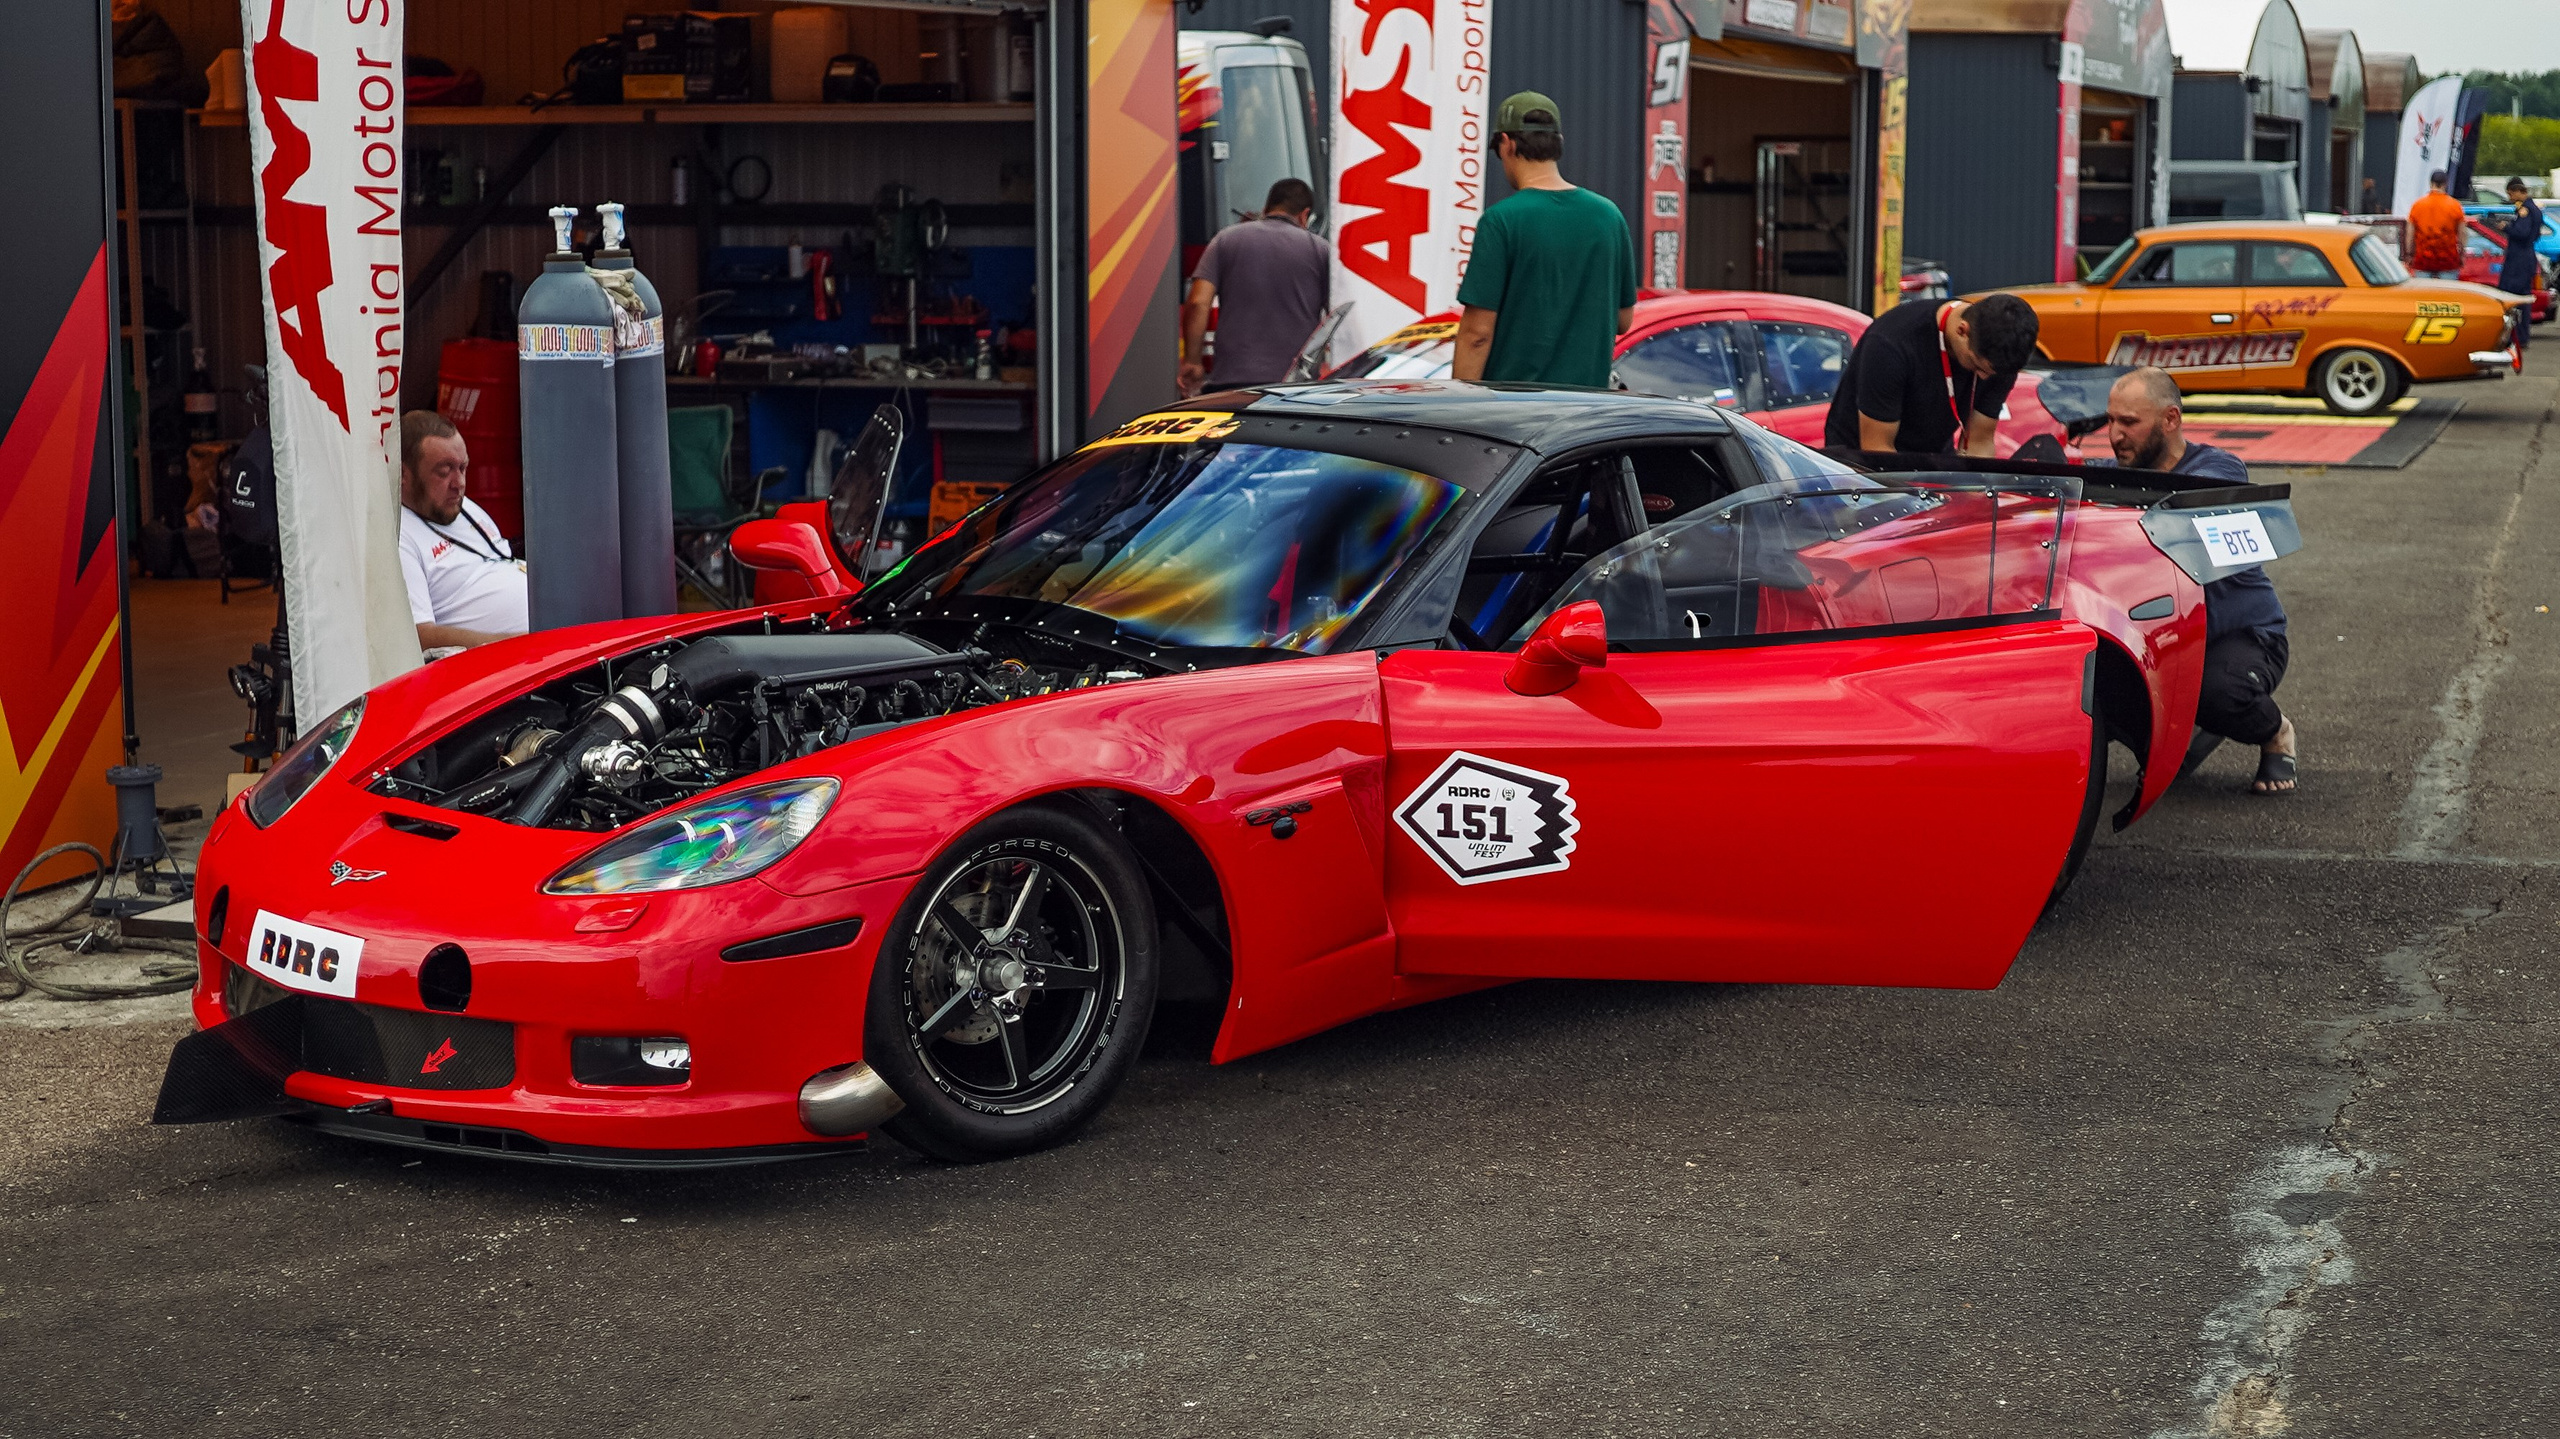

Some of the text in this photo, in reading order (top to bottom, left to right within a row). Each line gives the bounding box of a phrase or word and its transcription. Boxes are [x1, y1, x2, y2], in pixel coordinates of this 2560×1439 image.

[354, 47, 400, 236] Motor
[1454, 105, 1481, 212] Motor
[2404, 317, 2465, 344] 15
[2222, 529, 2259, 555] ВТБ
[1448, 786, 1490, 798] RDRC
[1437, 803, 1514, 843] 151
[970, 839, 1069, 862] FORGED
[260, 928, 339, 982] RDRC
[904, 936, 1001, 1115] WELD RACING
